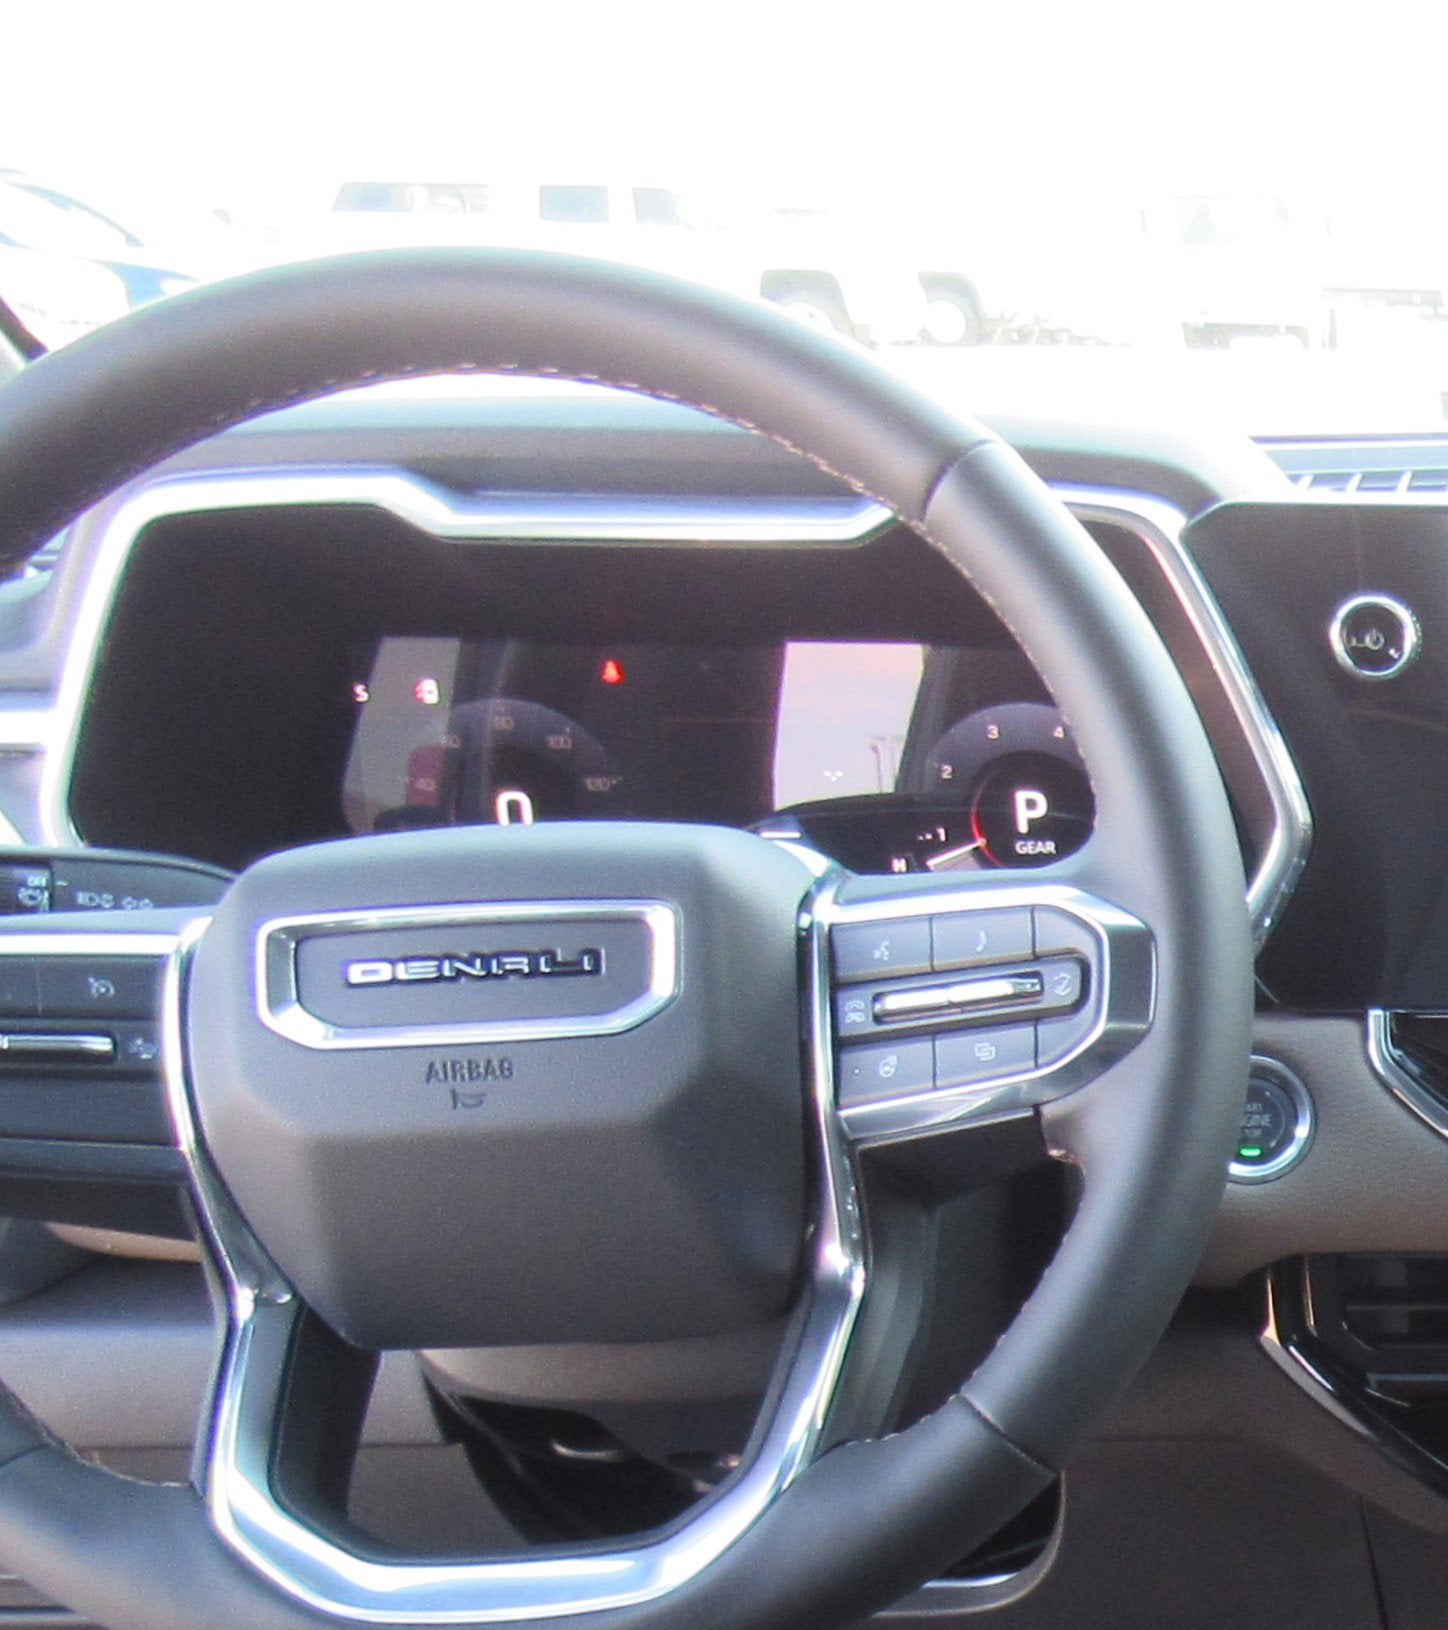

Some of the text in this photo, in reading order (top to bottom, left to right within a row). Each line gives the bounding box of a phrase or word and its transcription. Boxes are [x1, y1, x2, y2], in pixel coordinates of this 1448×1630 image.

[986, 724, 999, 739] 3
[1052, 725, 1065, 739] 4
[940, 764, 954, 779] 2
[1013, 788, 1048, 835] P
[1015, 840, 1057, 855] GEAR
[346, 947, 605, 986] DENALI
[425, 1058, 514, 1084] AIRBAG
